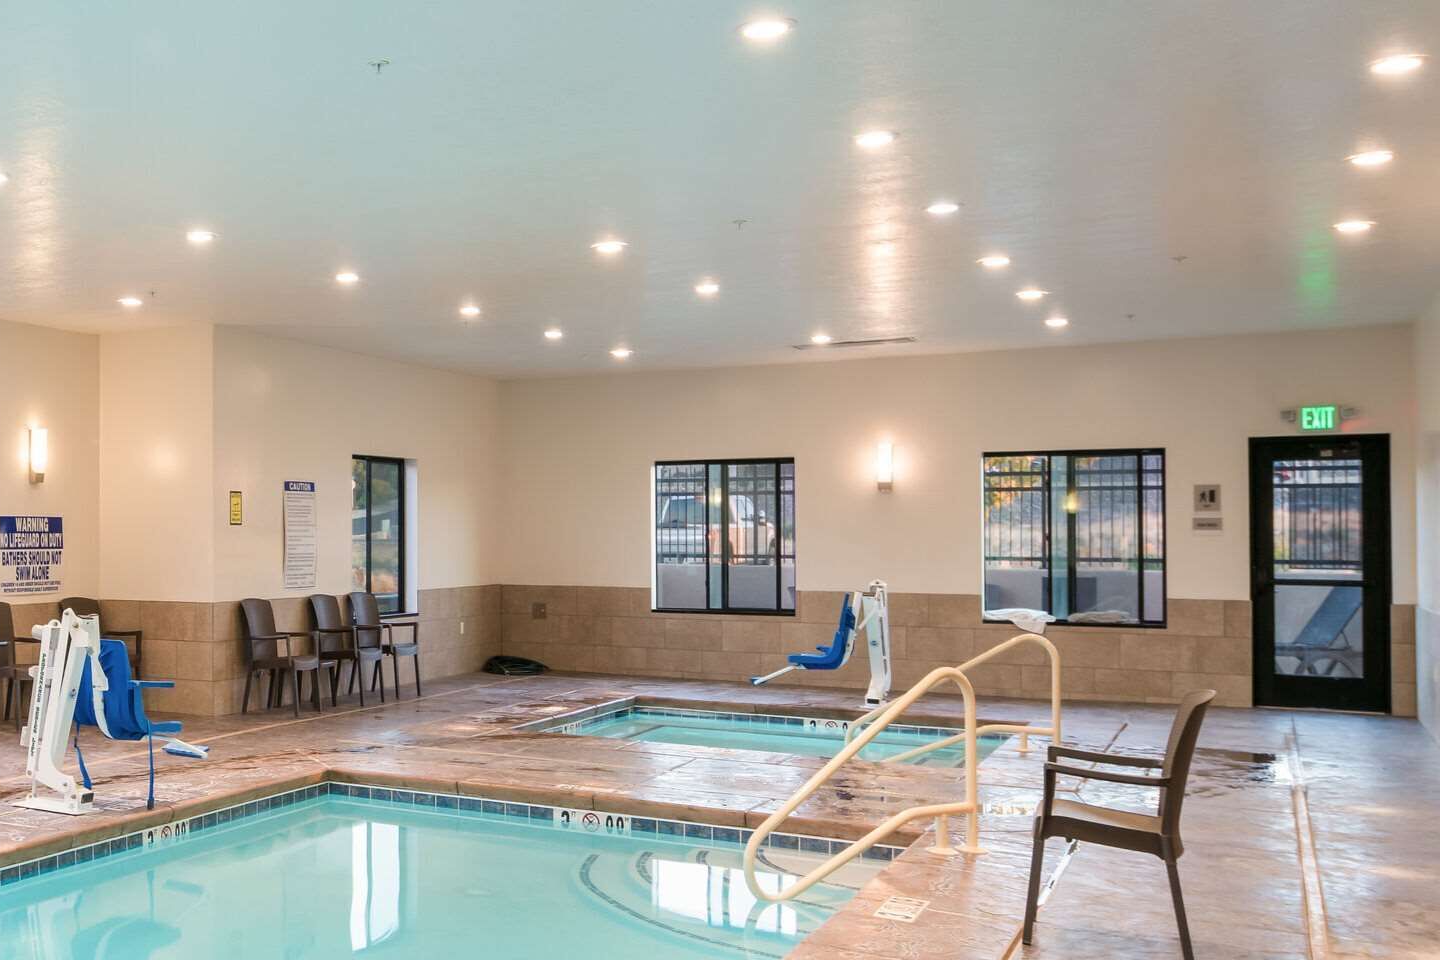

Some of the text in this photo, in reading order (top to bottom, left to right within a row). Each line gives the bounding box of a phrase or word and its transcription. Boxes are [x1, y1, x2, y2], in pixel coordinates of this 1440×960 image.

[1302, 407, 1335, 429] EXIT
[16, 517, 49, 532] WARNING
[1, 551, 28, 566] BATHERS
[28, 551, 50, 566] SHOULD
